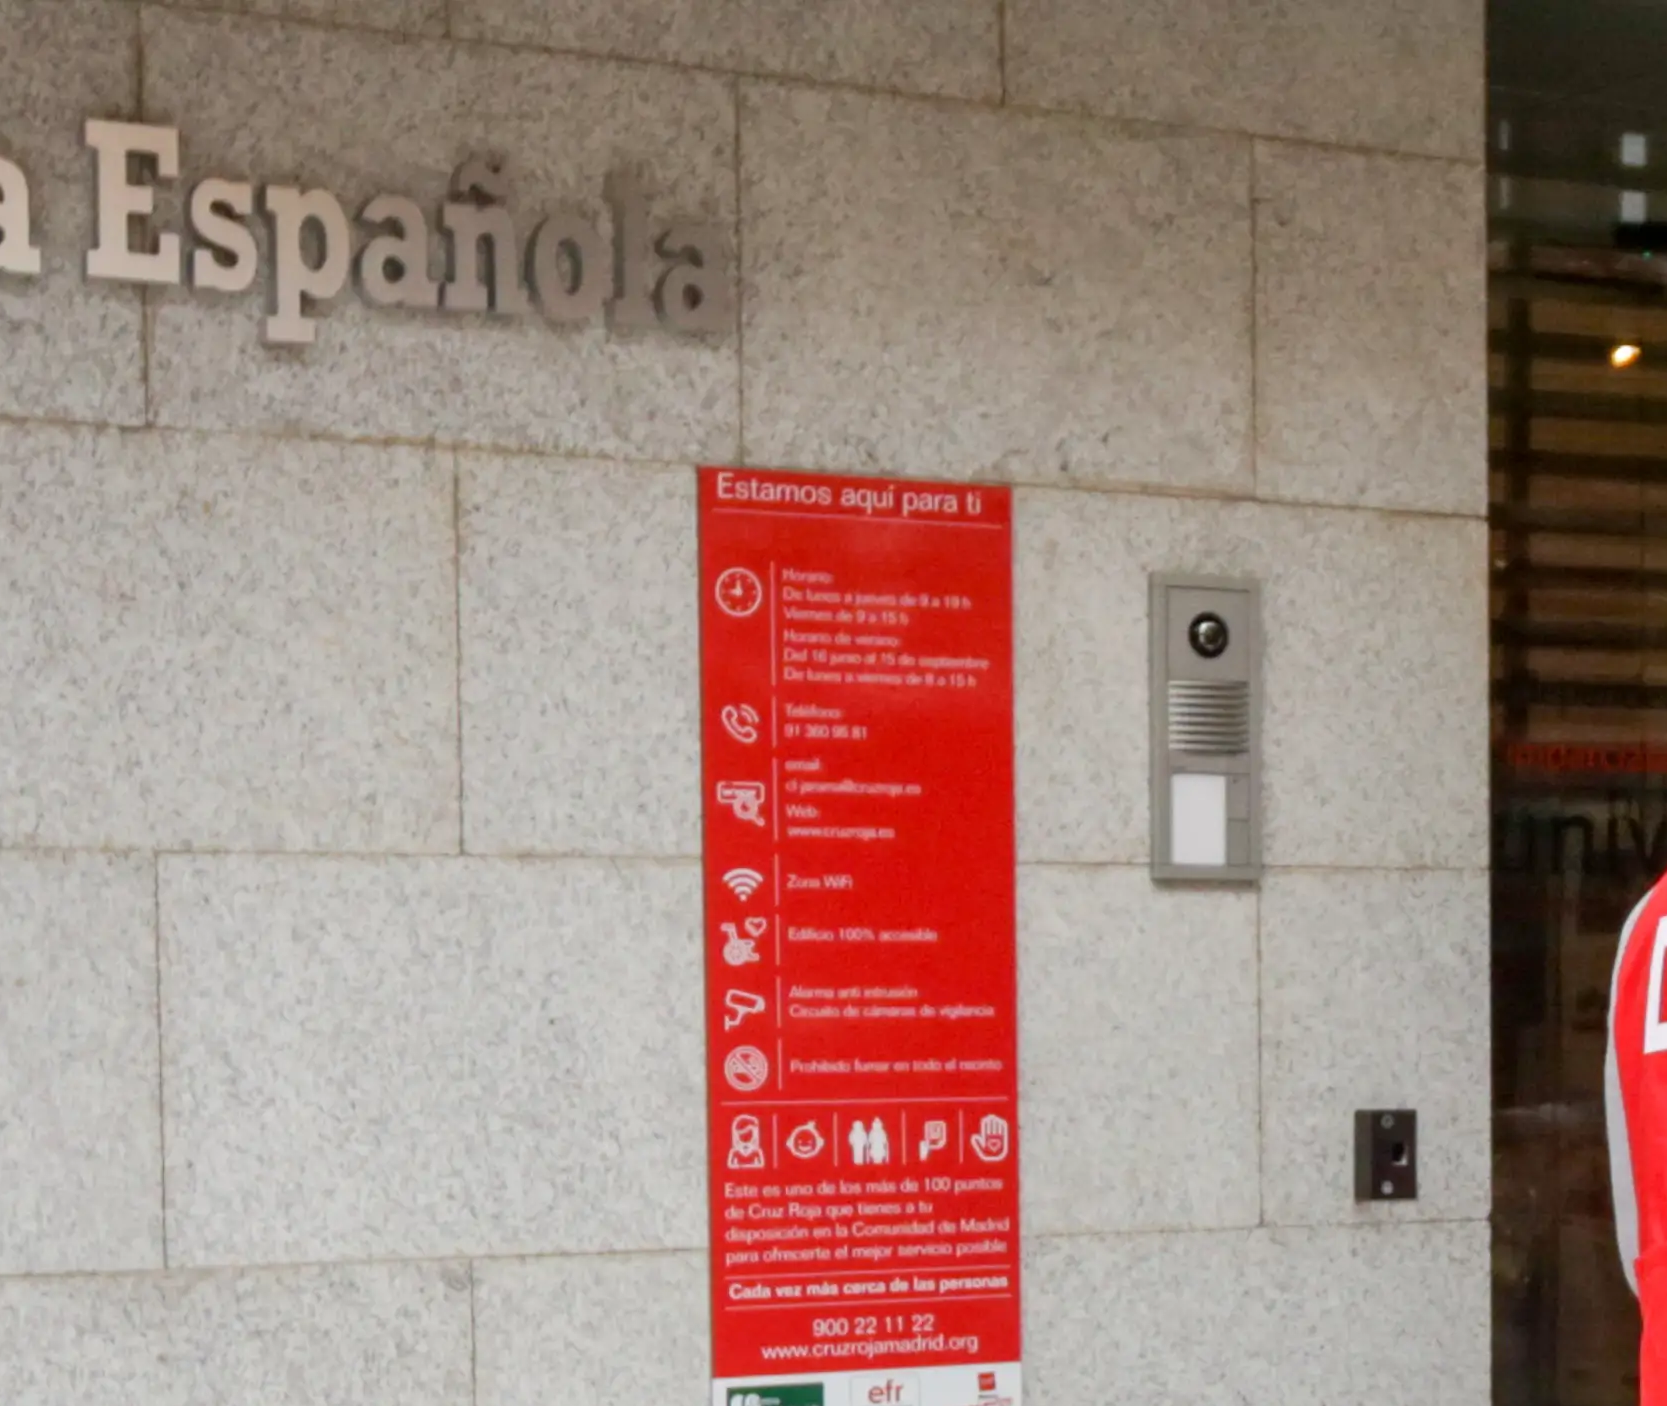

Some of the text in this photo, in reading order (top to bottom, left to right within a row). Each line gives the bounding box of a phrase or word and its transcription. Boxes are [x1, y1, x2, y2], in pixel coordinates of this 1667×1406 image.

[84, 117, 734, 343] Española
[716, 471, 982, 518] Estamos aquí para ti
[836, 609, 853, 622] de
[787, 874, 820, 889] Zona
[787, 926, 834, 941] Edificio
[838, 927, 875, 941] 100%
[843, 1004, 860, 1018] de
[919, 1004, 935, 1017] de
[790, 1058, 851, 1074] Prohibido
[724, 1177, 1003, 1198] Este es uno de los más de 100 puntos
[724, 1200, 933, 1221] de Cruz Roja que tienes a tu
[724, 1216, 1010, 1246] disposición en la Comunidad de Madrid
[724, 1238, 1007, 1268] para ofrecerte el mejor servicio posible
[728, 1275, 1009, 1300] Cada vez más cerca de las personas
[812, 1313, 935, 1337] 900 22 11 22
[760, 1333, 978, 1360] www.cruzrojamadrid.org
[867, 1378, 906, 1405] efr
